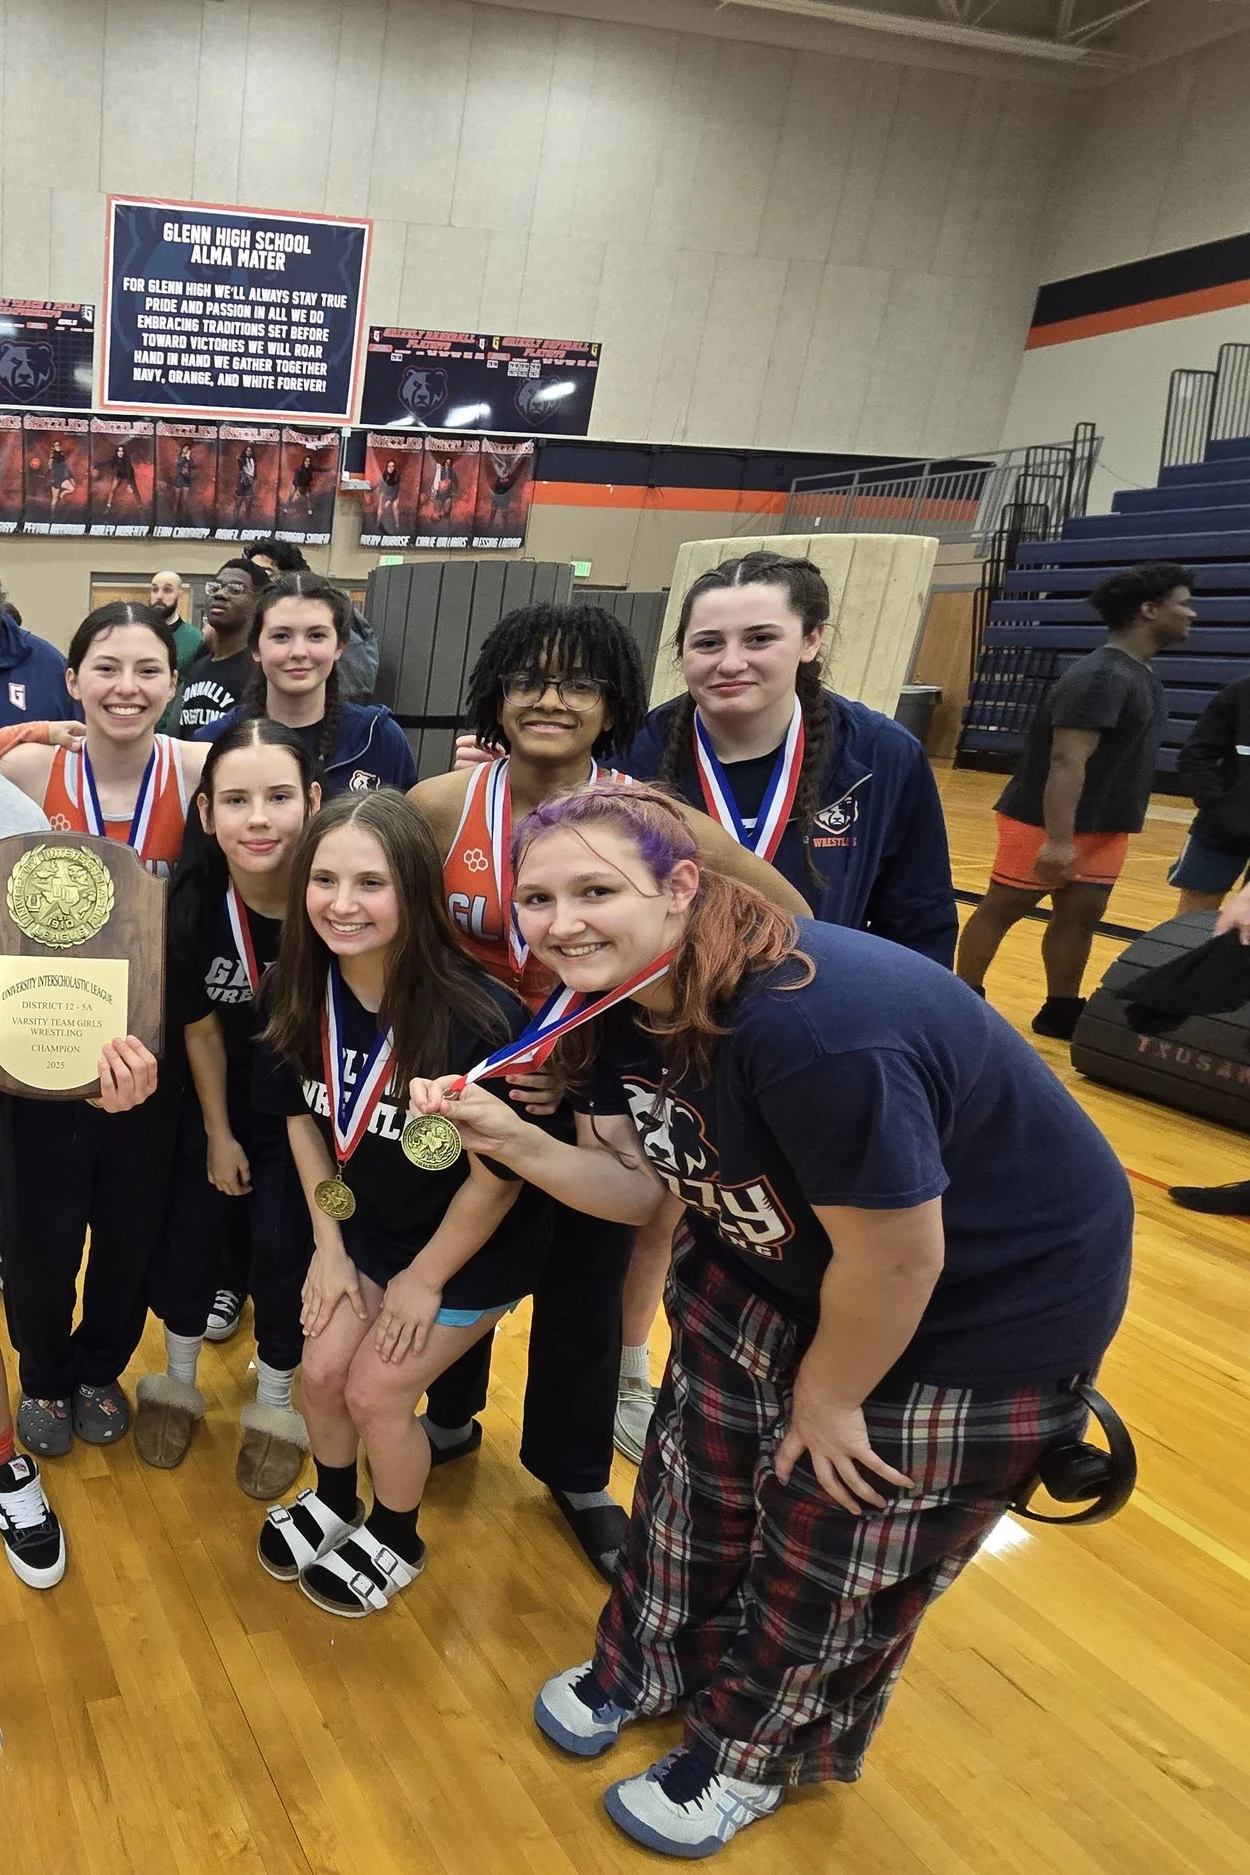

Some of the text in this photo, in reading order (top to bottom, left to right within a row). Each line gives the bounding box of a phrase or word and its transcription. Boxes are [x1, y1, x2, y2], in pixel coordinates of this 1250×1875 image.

[163, 222, 311, 255] GLENN HIGH SCHOOL
[190, 246, 286, 271] ALMA MATER
[123, 277, 348, 309] FOR GLENN HIGH WE'LL ALWAYS STAY TRUE
[145, 297, 324, 324] PRIDE AND PASSION IN ALL WE DO
[137, 314, 329, 342] EMBRACING TRADITIONS SET BEFORE
[142, 332, 323, 359] TOWARD VICTORIES WE WILL ROAR
[134, 350, 328, 376] HAND IN HAND WE GATHER TOGETHER
[133, 367, 327, 393] NAVY, ORANGE, AND WHITE FOREVER!
[182, 680, 235, 708] ONNALLY
[32, 922, 89, 941] LEAGUE
[2, 974, 113, 1005] UNIVERSITY INTERSCHOLASTIC LEAGUE
[22, 1001, 63, 1011] DISTRICT
[65, 1003, 75, 1011] 12
[12, 1017, 102, 1028] VARSITY TEAM GIRLS
[30, 1028, 83, 1038] WRESTLING
[31, 1043, 81, 1053] CHAMPION
[46, 1060, 65, 1069] 2025
